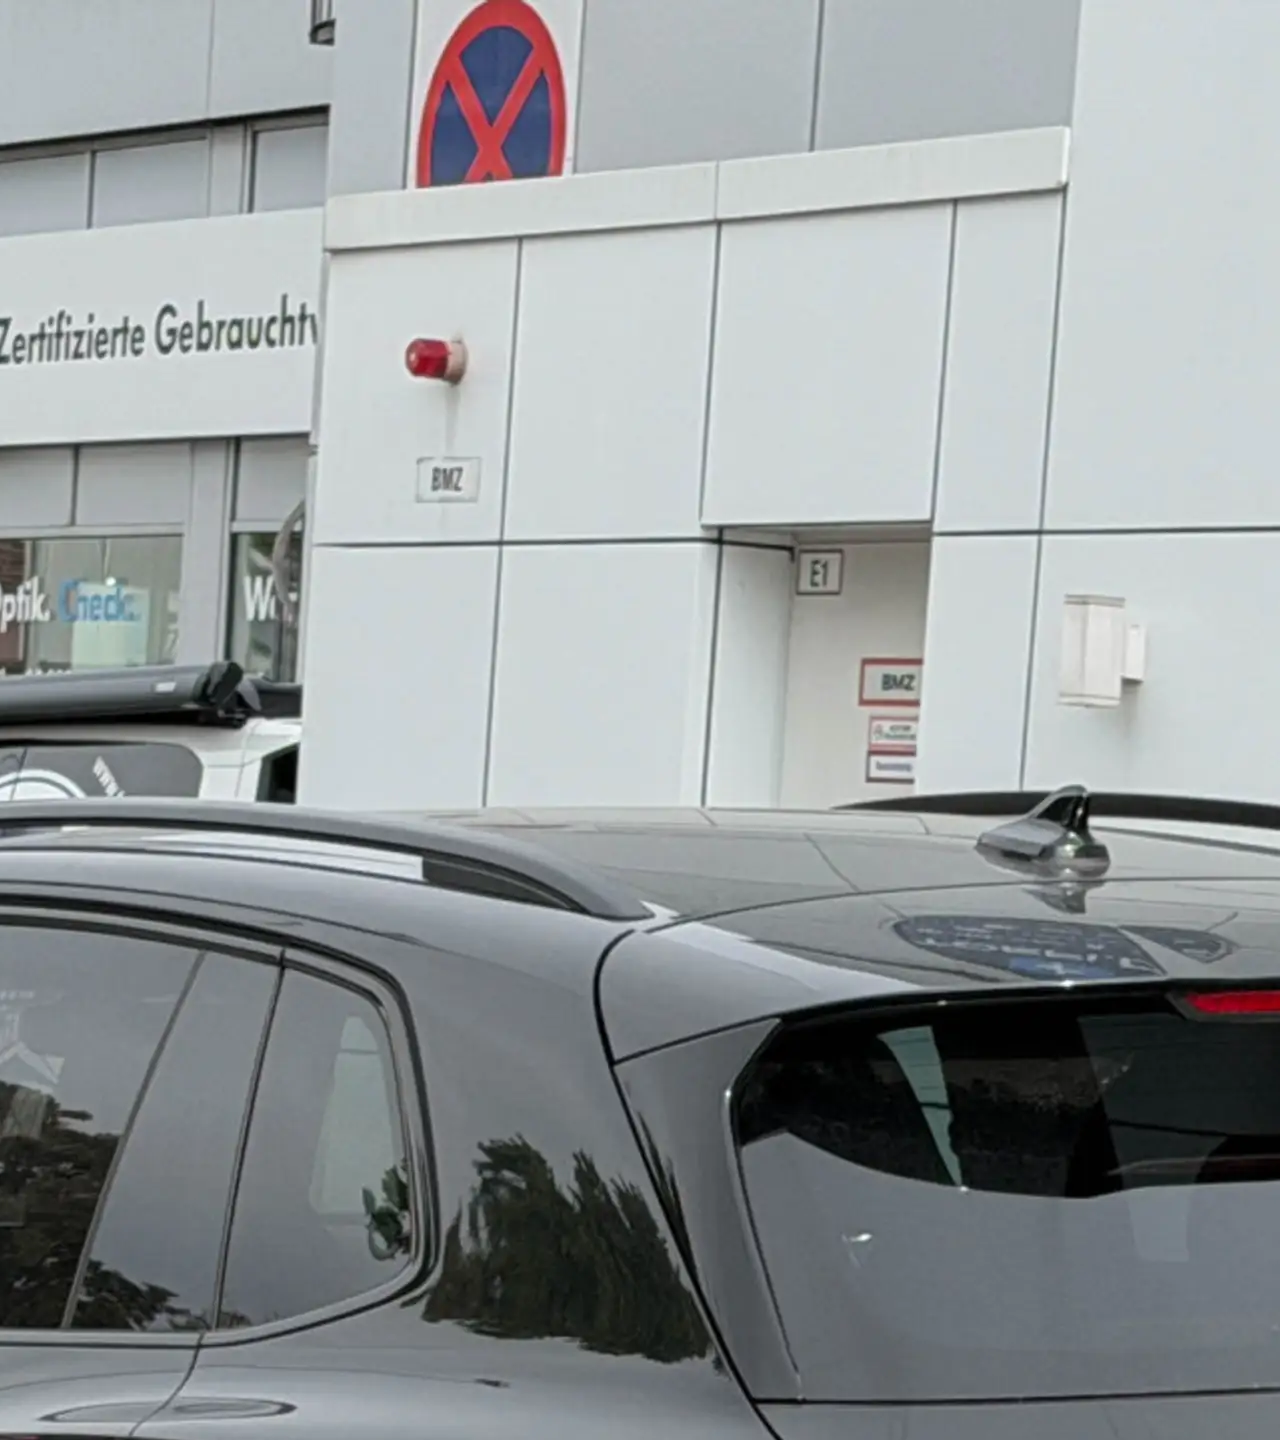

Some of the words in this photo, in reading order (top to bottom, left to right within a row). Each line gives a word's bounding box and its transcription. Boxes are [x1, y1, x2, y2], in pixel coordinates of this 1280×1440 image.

[431, 466, 463, 492] BMZ
[809, 559, 829, 588] E1
[881, 673, 916, 691] BMZ
